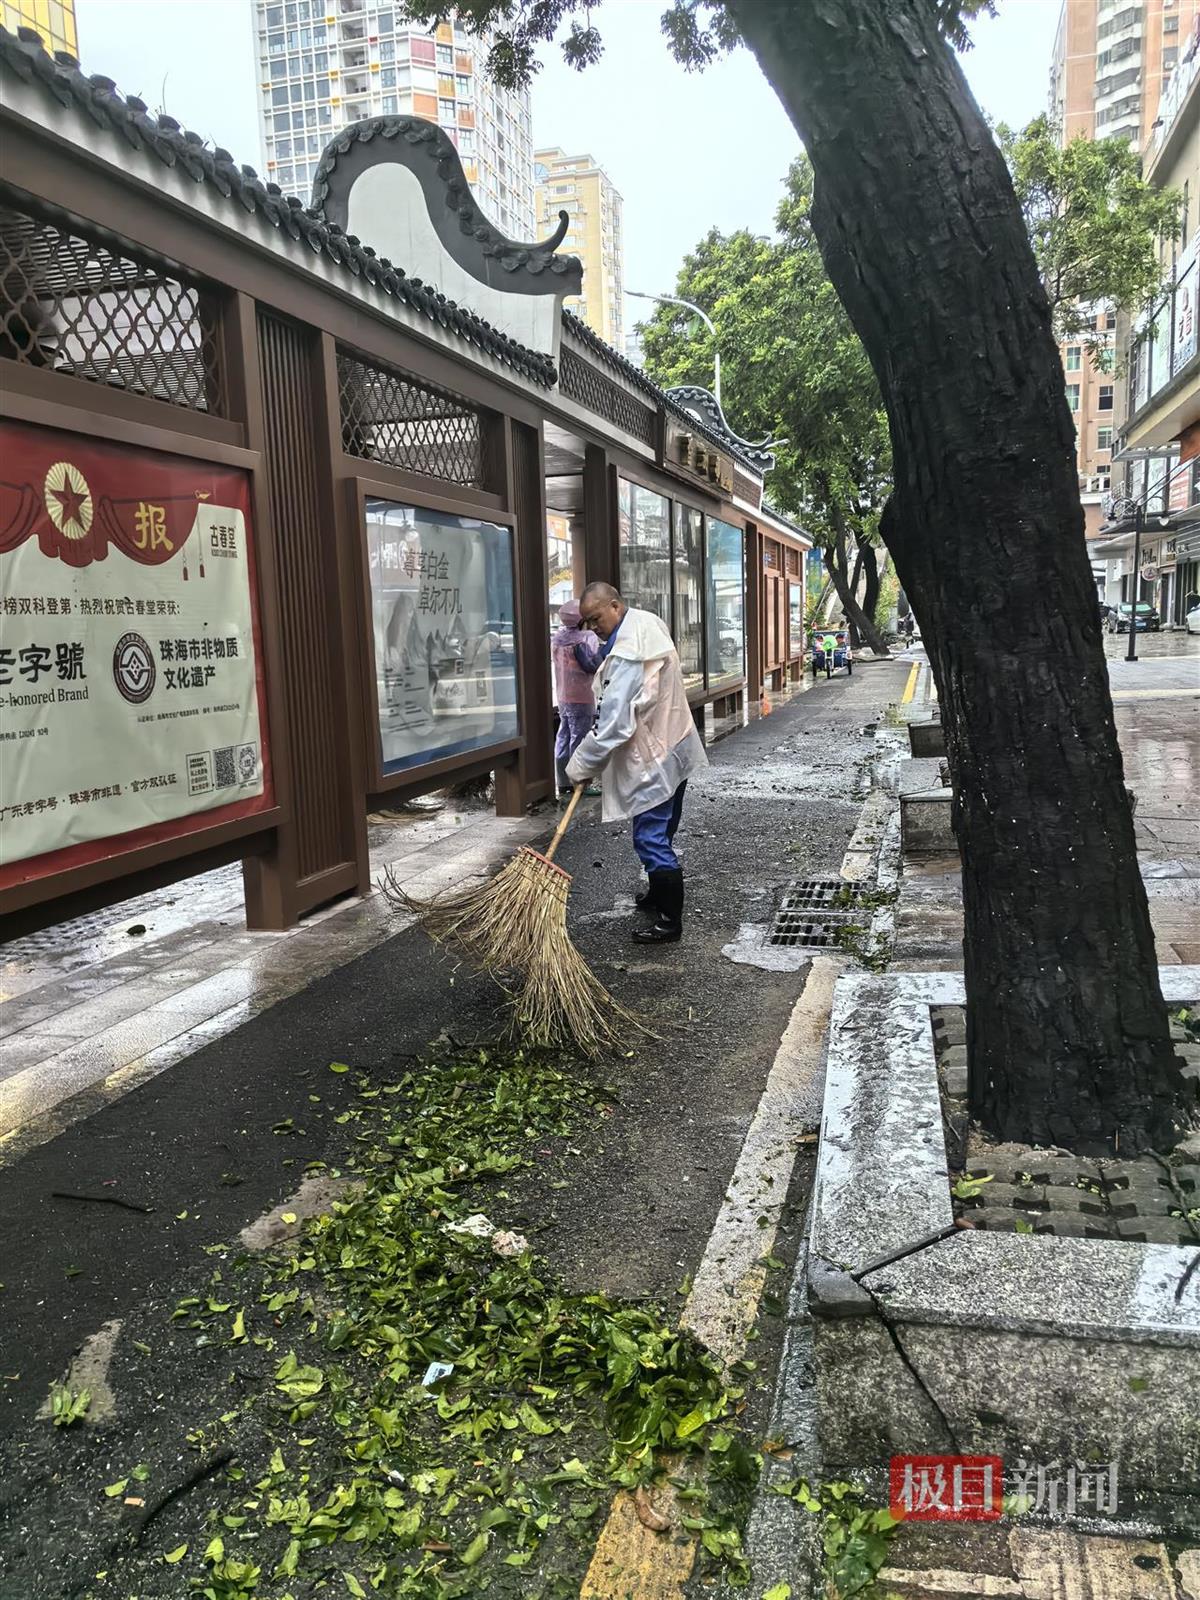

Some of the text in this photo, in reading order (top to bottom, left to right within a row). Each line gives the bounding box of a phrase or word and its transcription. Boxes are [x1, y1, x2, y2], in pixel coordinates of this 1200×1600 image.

[134, 502, 174, 551] 报
[209, 524, 237, 549] 古春堂
[159, 637, 239, 661] 珠海市非物质
[163, 664, 216, 690] 文化遗产
[57, 686, 89, 702] Brand
